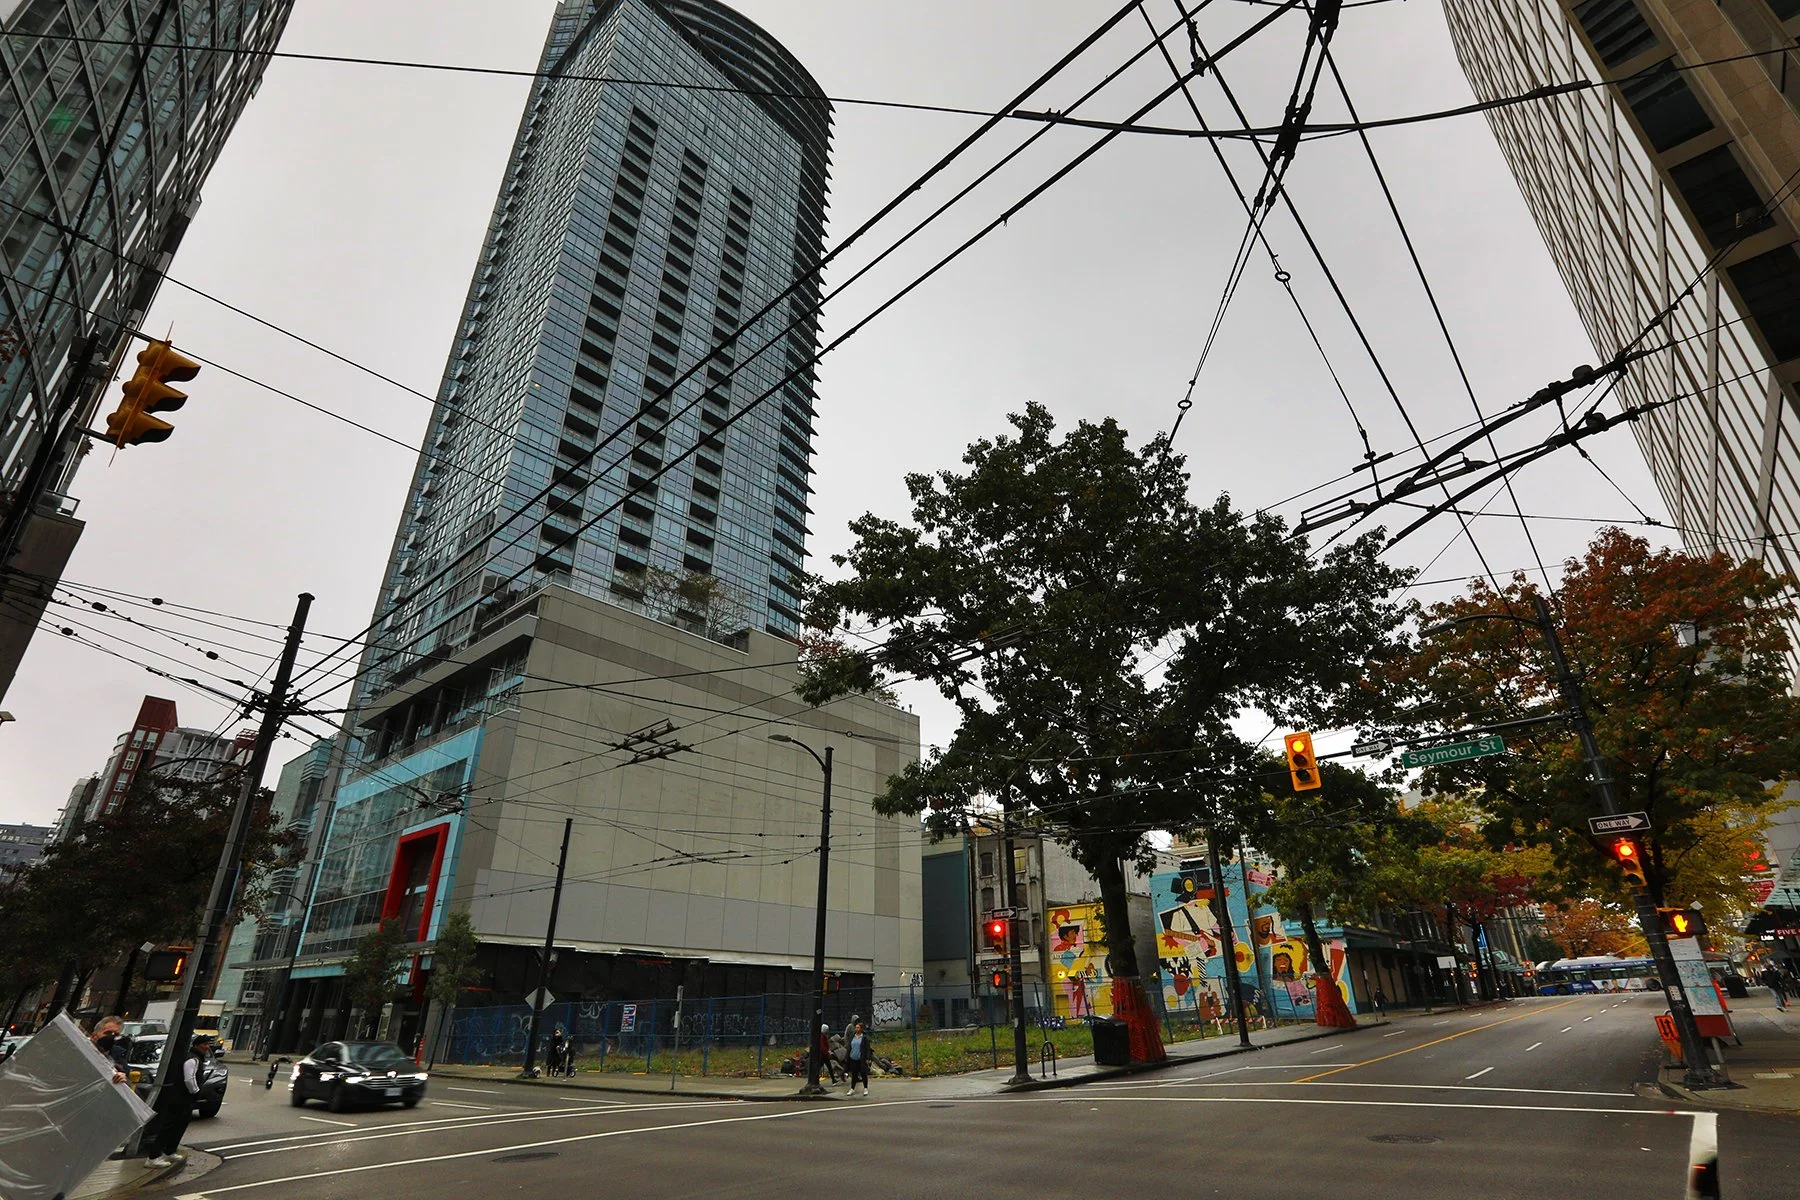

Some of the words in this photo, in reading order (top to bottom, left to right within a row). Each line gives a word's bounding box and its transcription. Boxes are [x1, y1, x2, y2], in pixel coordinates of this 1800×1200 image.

[1408, 745, 1472, 765] Seymour
[1479, 739, 1497, 752] St
[1597, 821, 1612, 829] ONE
[1615, 819, 1630, 827] WAY
